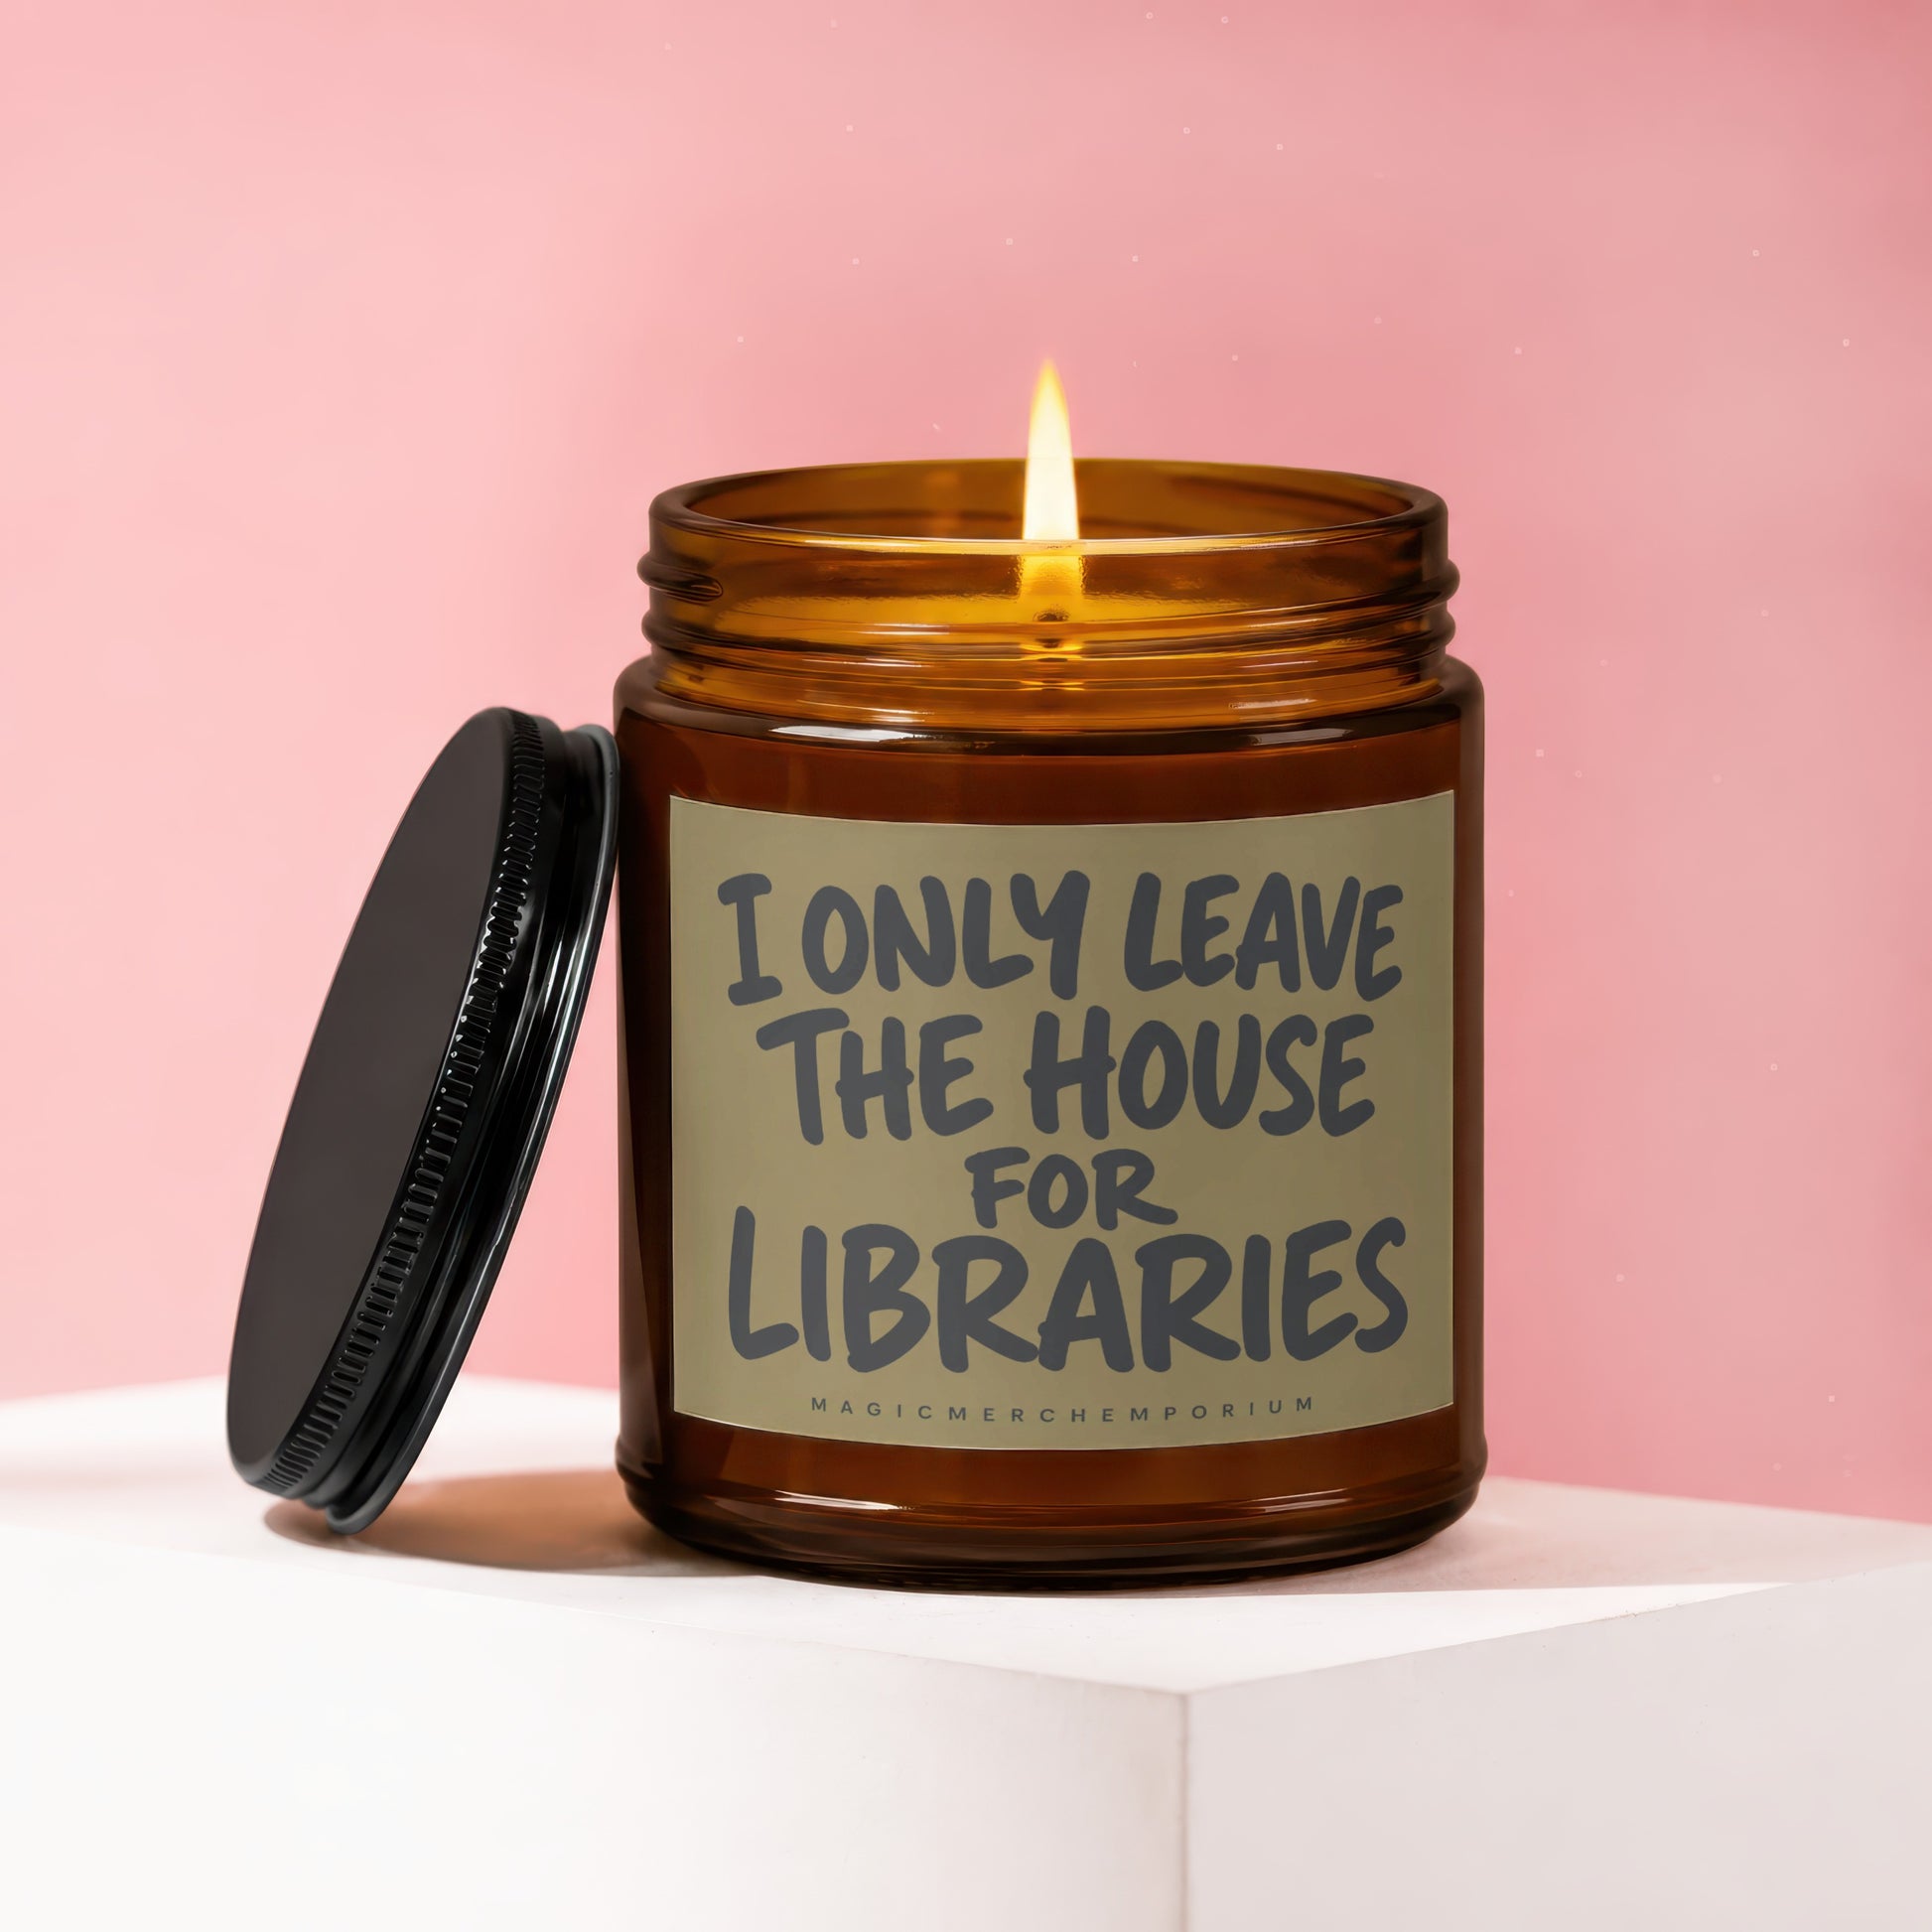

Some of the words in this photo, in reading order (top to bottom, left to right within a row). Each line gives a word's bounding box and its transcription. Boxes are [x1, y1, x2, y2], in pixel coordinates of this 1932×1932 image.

[717, 872, 783, 1007] I
[801, 869, 1091, 1002] ONLY
[1123, 871, 1405, 1003] LEAVE
[755, 1007, 995, 1147] THE
[1023, 1004, 1376, 1142] HOUSE
[963, 1146, 1179, 1232] FOR
[728, 1205, 1410, 1374] LIBRARIES
[810, 1396, 1314, 1424] MAGICMERCHEMPORIUM
